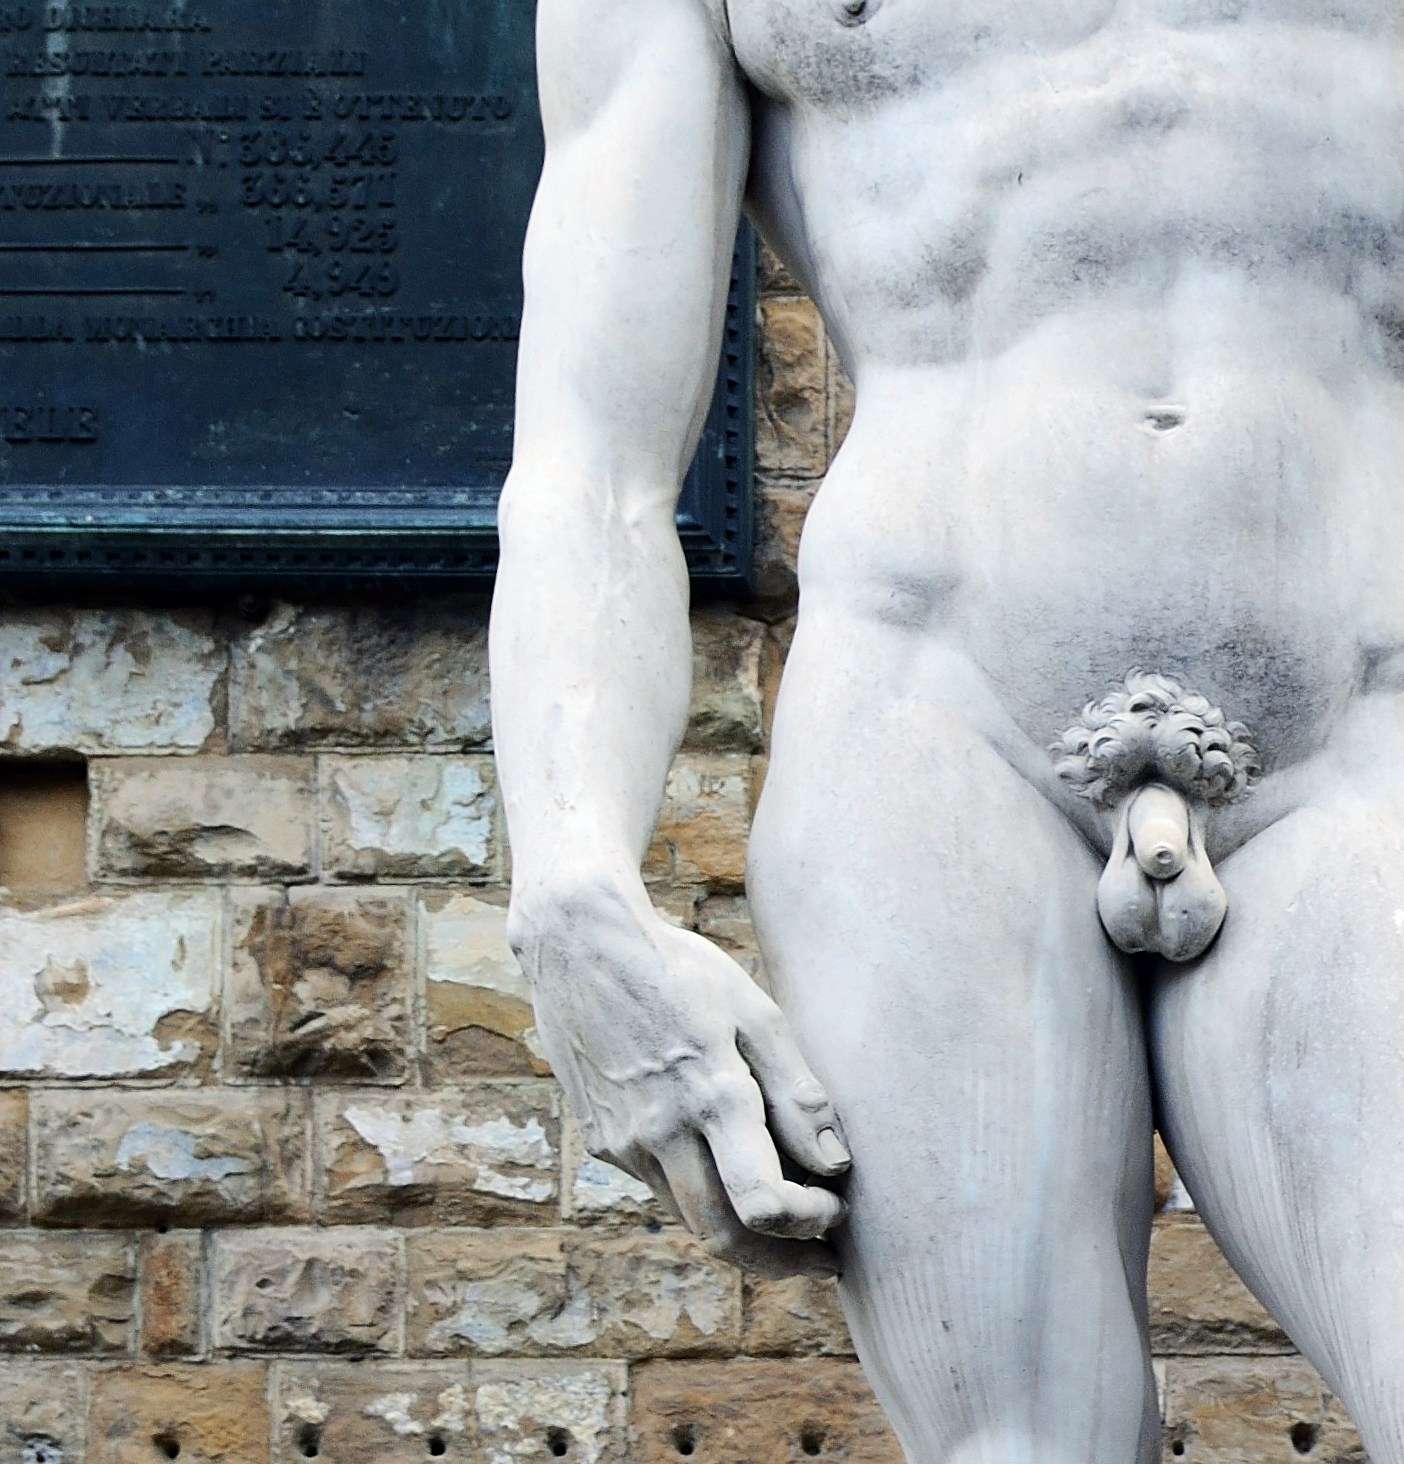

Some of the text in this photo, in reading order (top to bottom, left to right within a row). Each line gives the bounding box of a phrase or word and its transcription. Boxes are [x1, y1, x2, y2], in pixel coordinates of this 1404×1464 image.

[240, 171, 398, 214] 366,571
[264, 215, 399, 260] 14,925
[281, 259, 401, 304] 4,949
